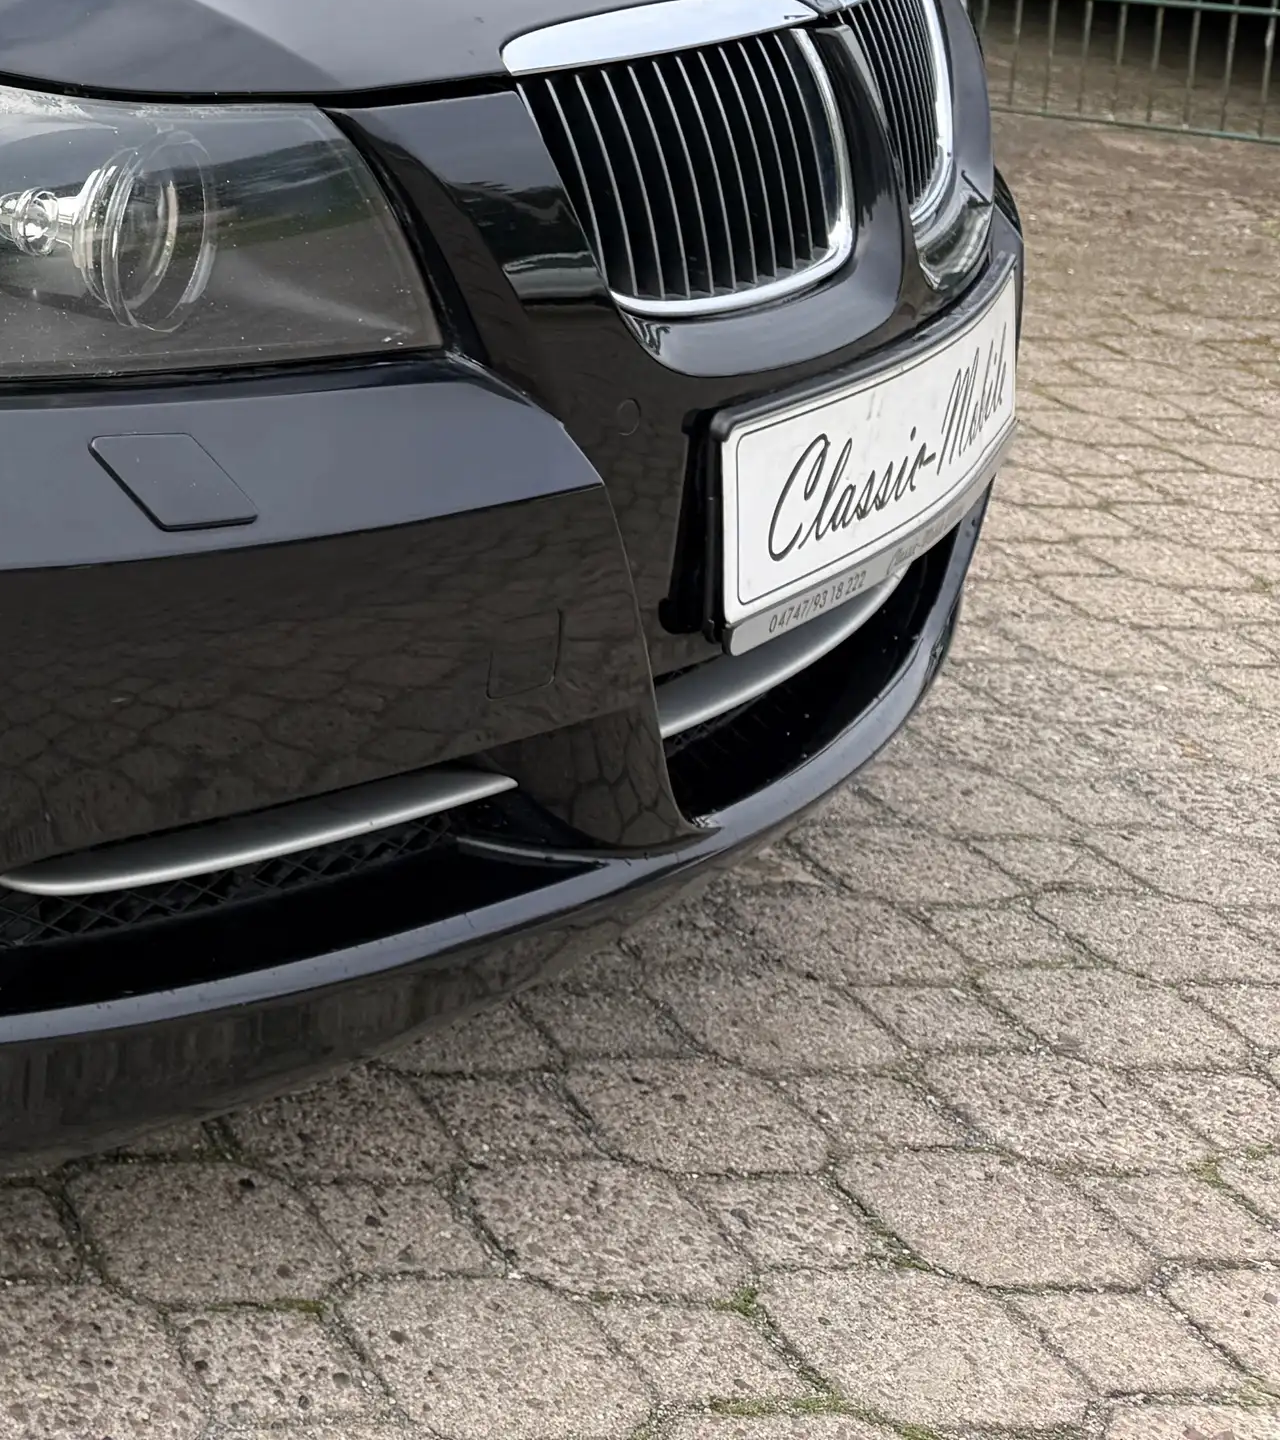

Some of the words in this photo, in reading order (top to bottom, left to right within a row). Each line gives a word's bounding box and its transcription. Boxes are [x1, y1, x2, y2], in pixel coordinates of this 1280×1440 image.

[768, 589, 828, 633] 04747/93
[830, 581, 845, 603] 18
[845, 570, 867, 596] 222
